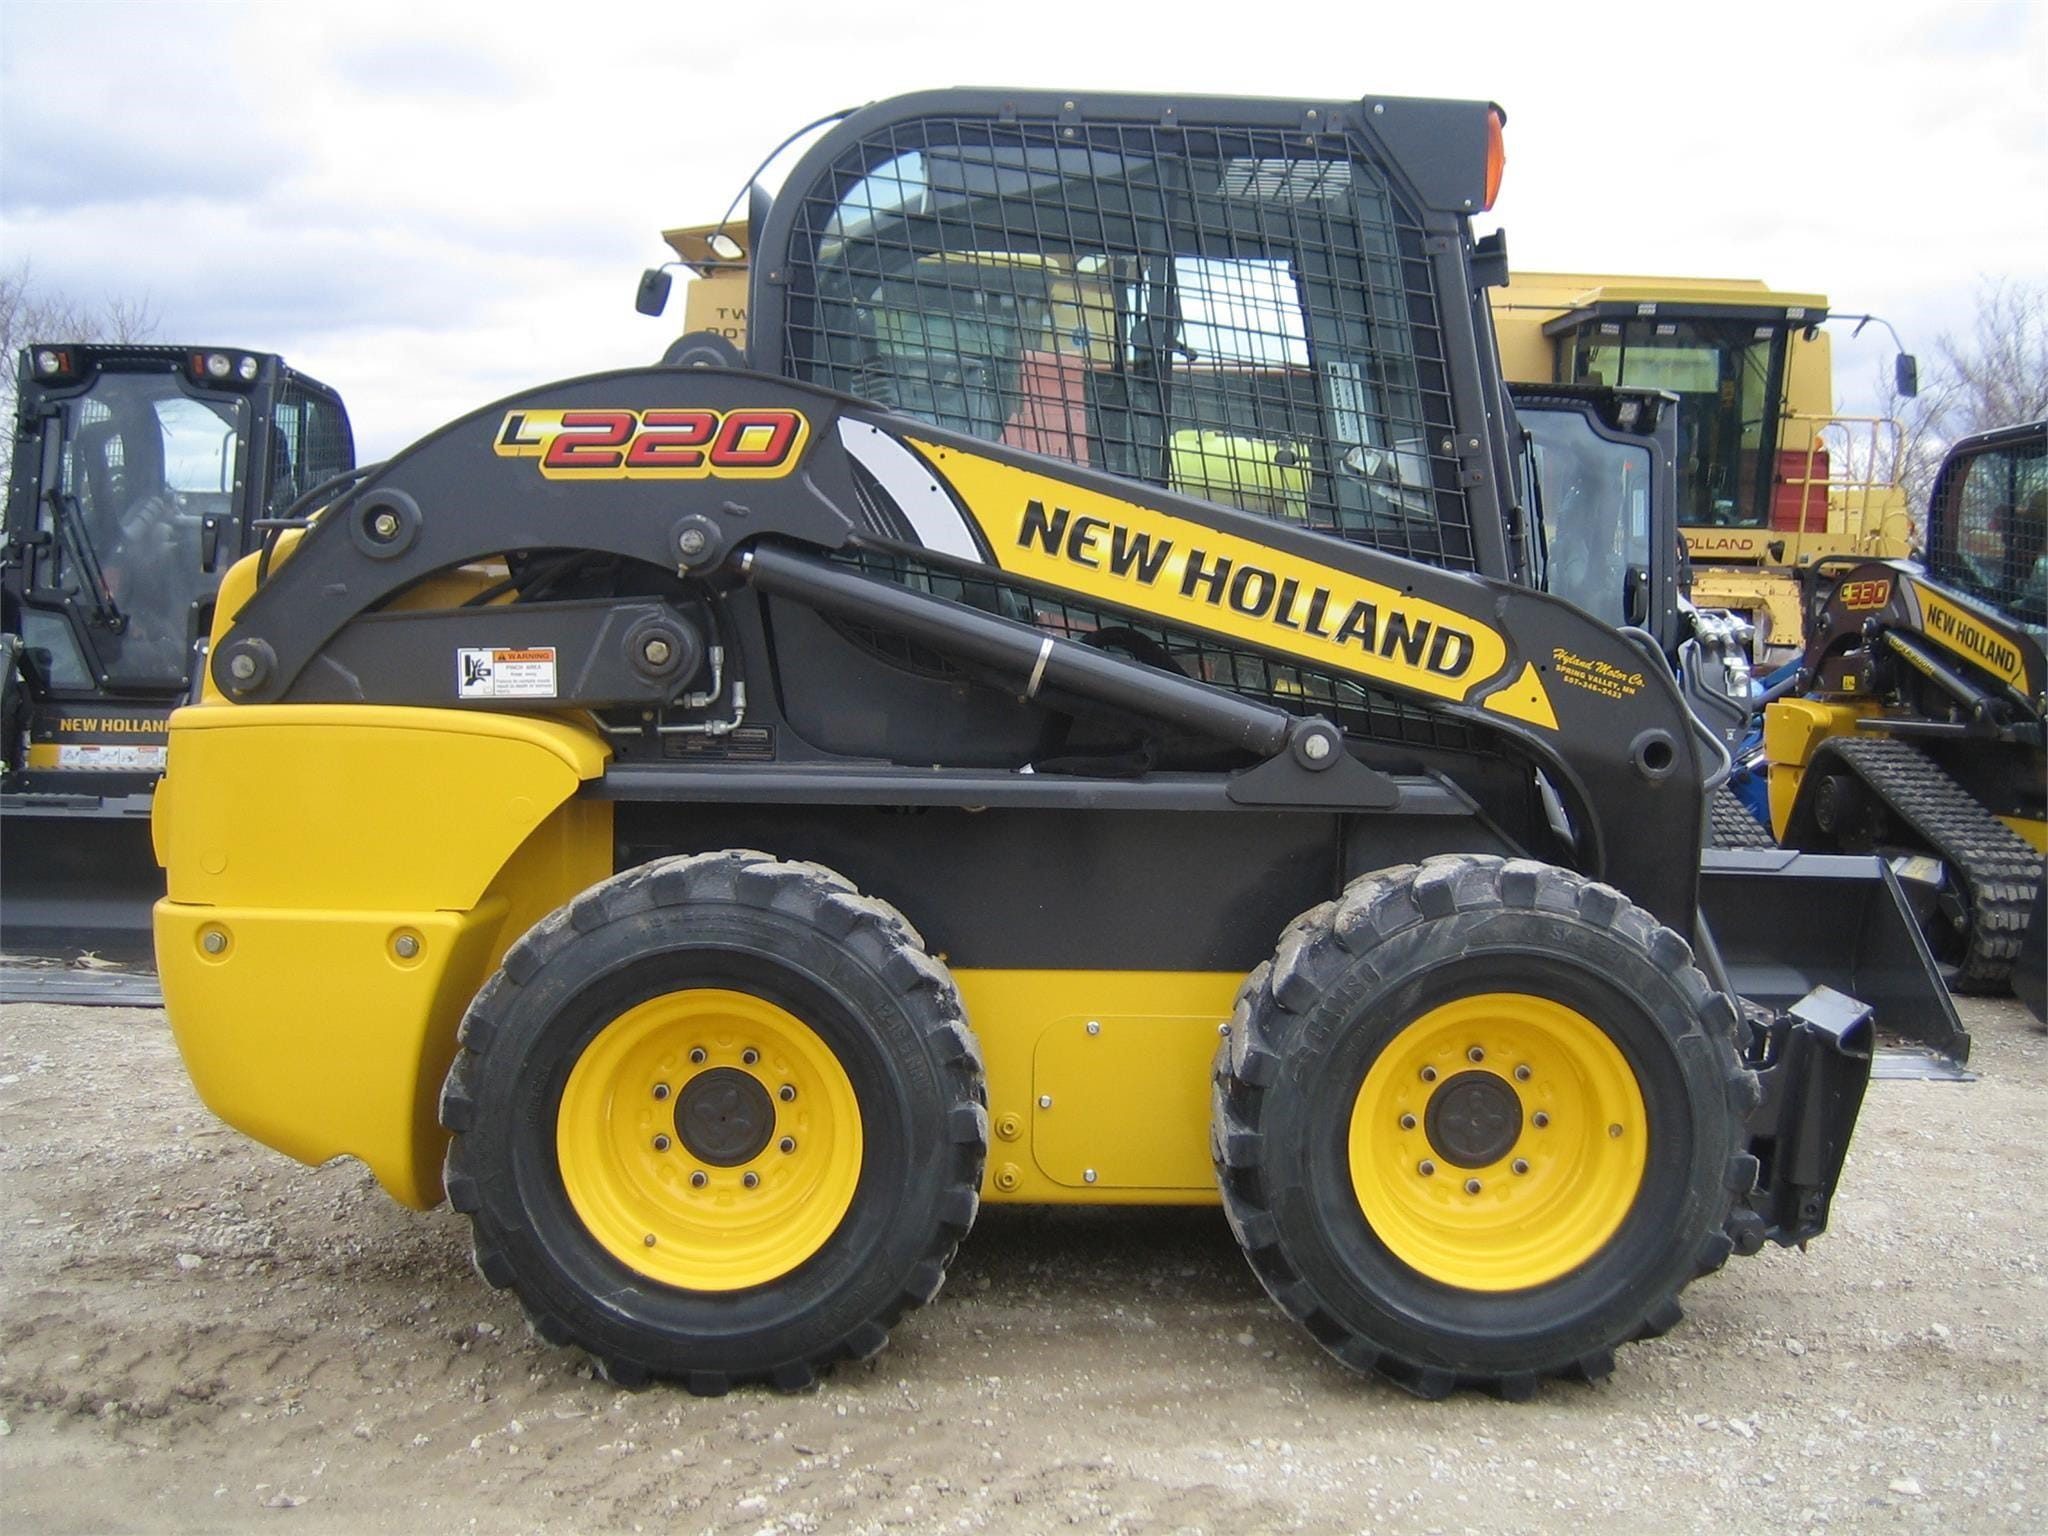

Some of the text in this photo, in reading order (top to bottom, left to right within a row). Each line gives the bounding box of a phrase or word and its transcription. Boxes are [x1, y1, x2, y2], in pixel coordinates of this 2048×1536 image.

[498, 410, 804, 472] L220
[1017, 499, 1476, 679] NEW HOLLAND
[508, 652, 550, 660] WARNING
[1927, 603, 2016, 674] NEW HOLLAND
[1552, 648, 1645, 687] Hyland Motor Co.
[1555, 664, 1586, 678] SPRING
[1622, 686, 1636, 695] MN
[60, 718, 98, 732] NEW
